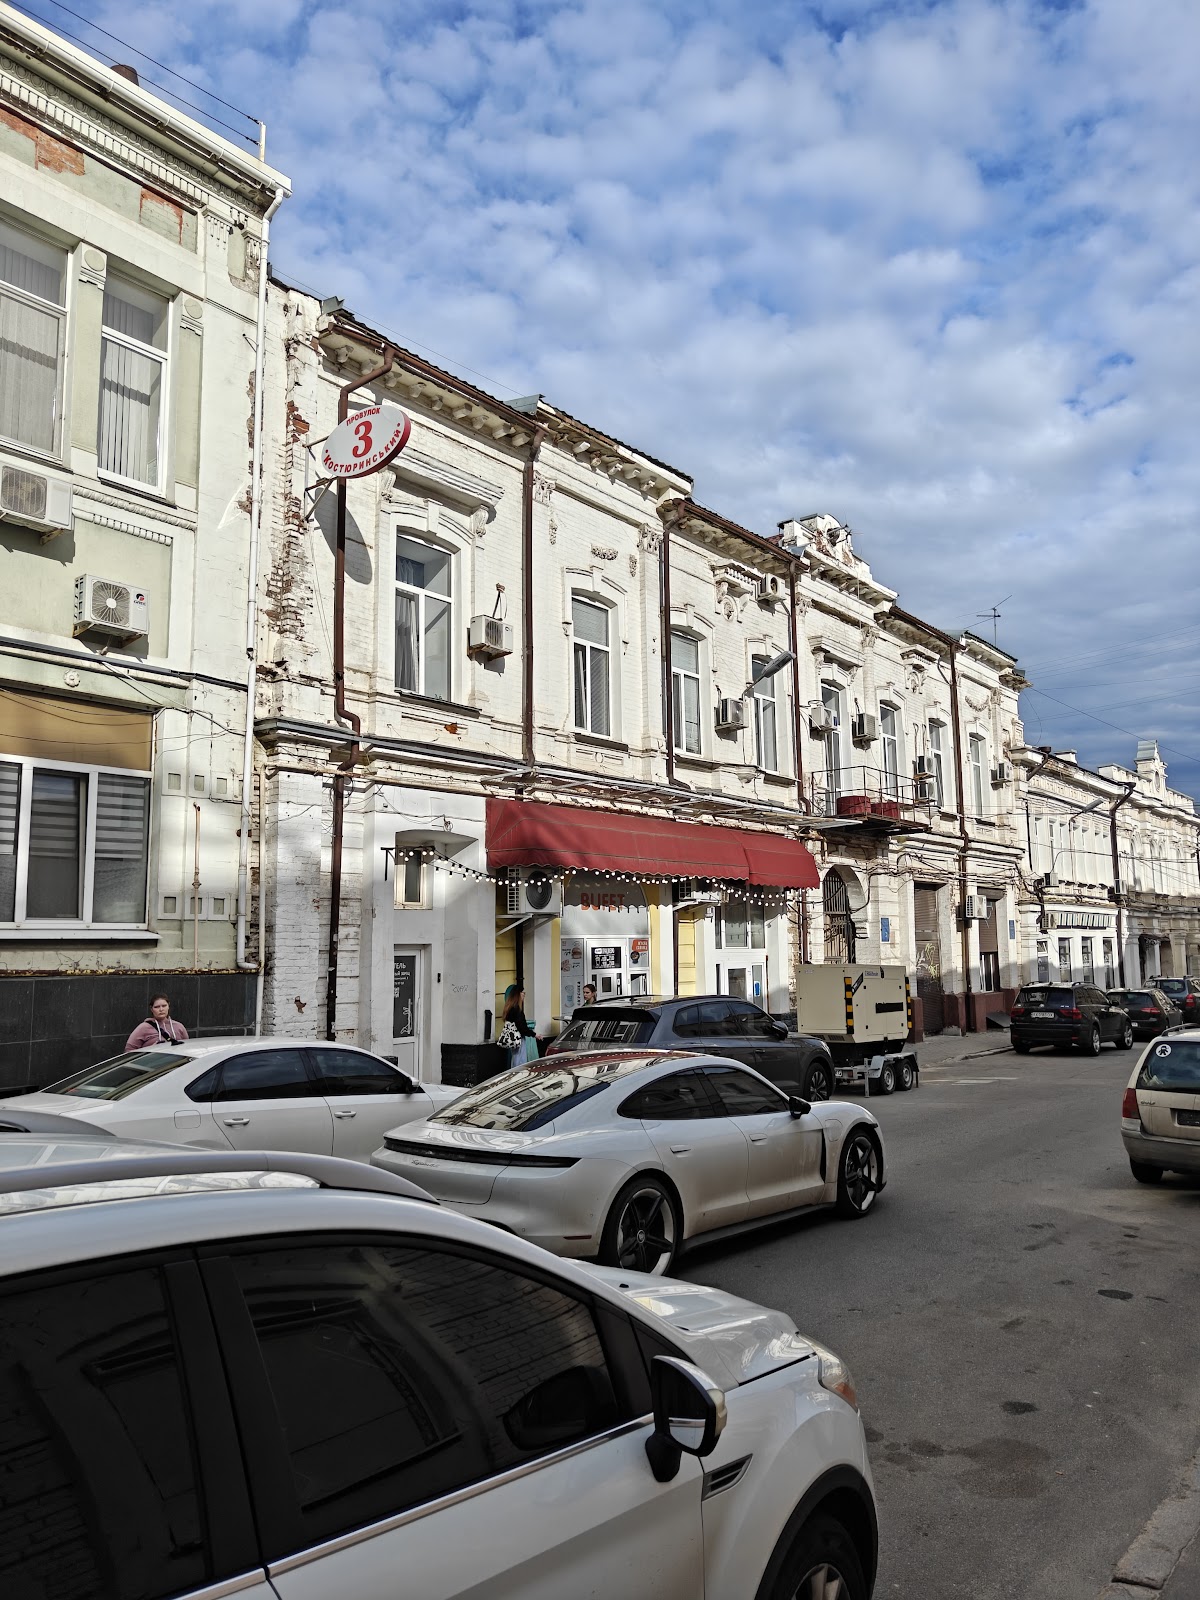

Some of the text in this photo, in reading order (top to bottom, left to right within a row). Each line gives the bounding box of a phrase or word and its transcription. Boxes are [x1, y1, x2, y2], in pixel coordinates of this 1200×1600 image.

[346, 407, 381, 426] ПРОВУЛОК
[323, 429, 402, 473] КОСТЮРИНСЬКИЙ
[352, 420, 373, 458] 3
[580, 893, 625, 911] BUFET
